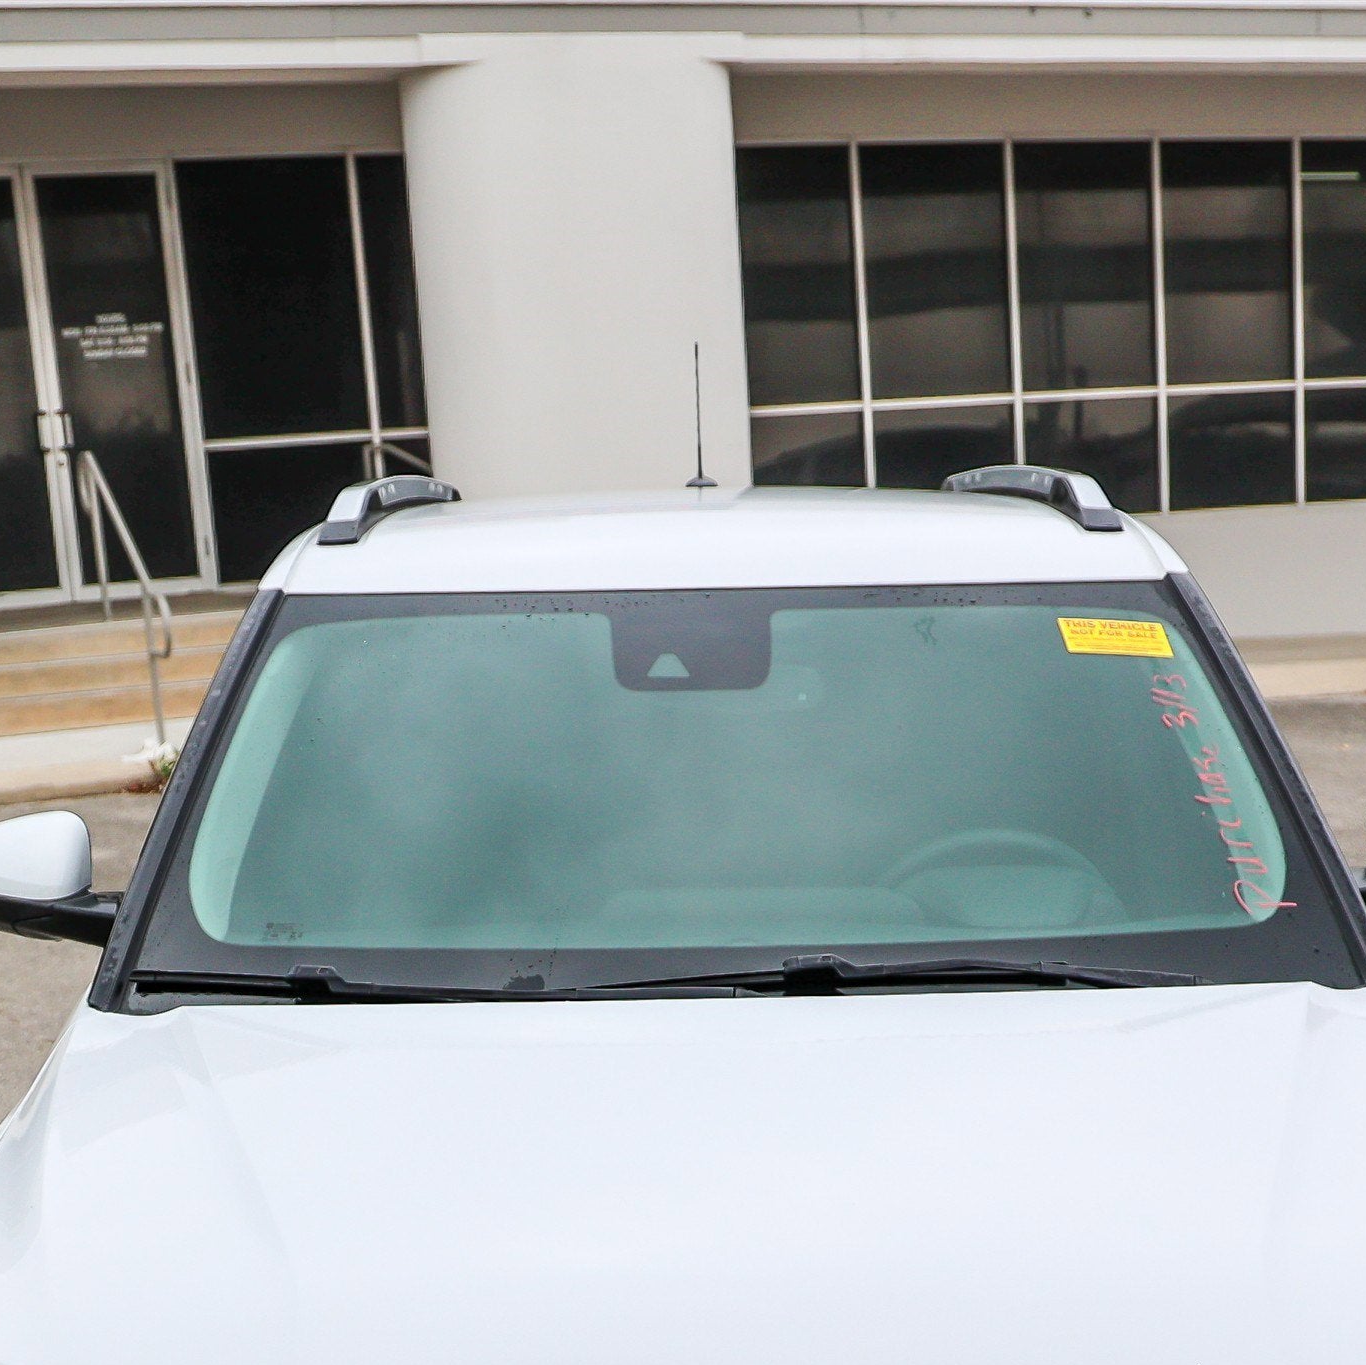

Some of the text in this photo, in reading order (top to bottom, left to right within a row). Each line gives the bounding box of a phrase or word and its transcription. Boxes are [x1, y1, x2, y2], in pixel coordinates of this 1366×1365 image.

[1064, 619, 1158, 632] THIS VEHICLE
[1098, 629, 1123, 637] FOR
[1127, 632, 1158, 640] SALE
